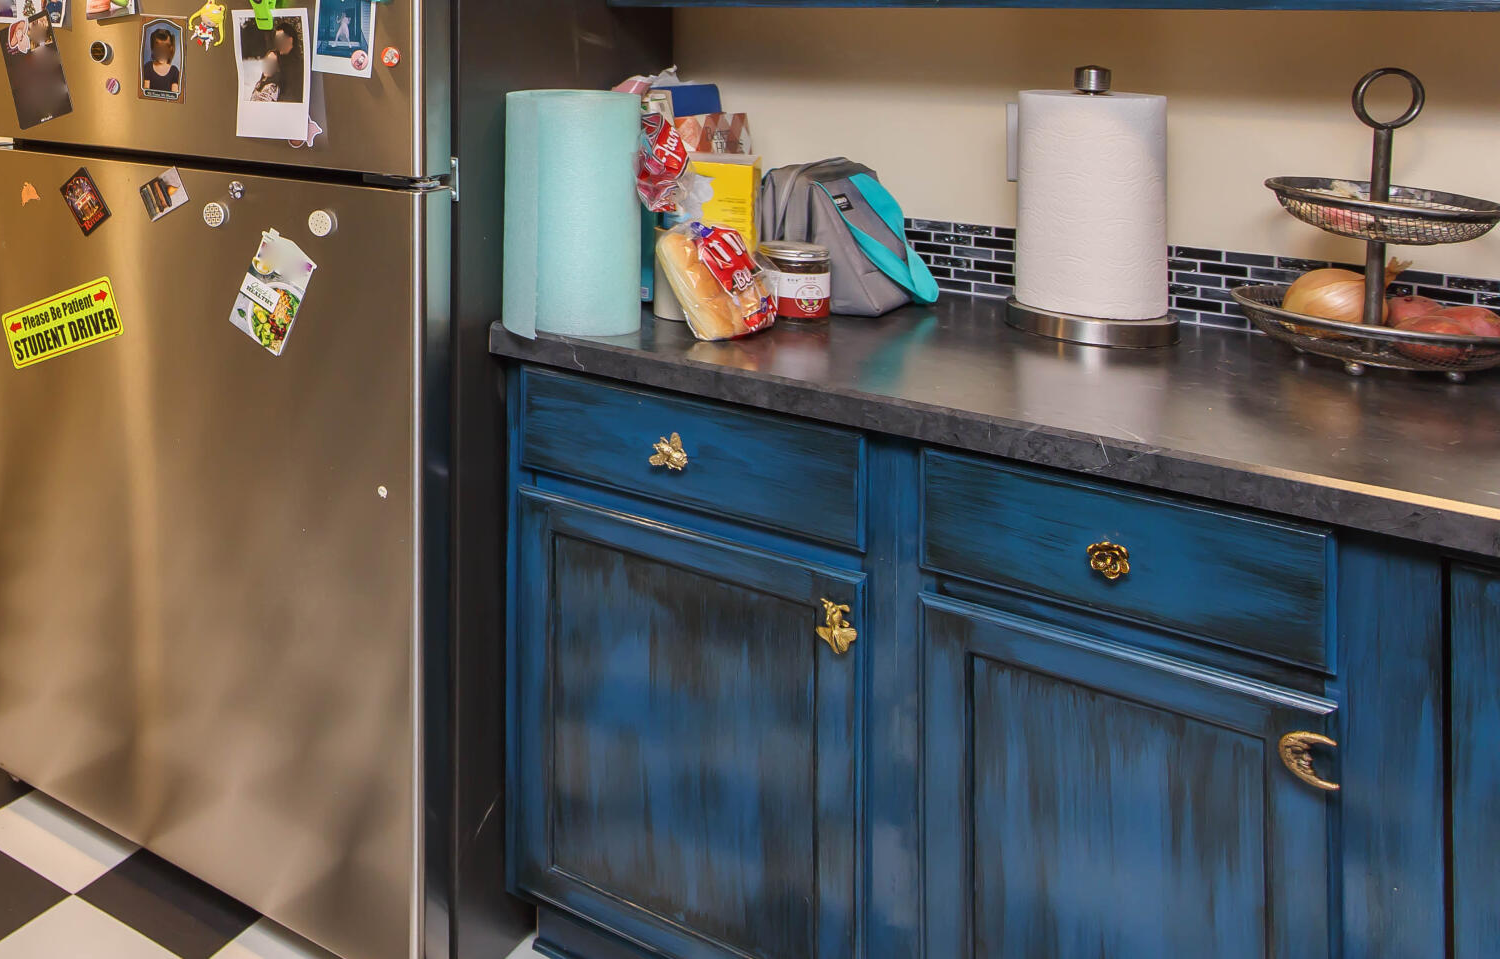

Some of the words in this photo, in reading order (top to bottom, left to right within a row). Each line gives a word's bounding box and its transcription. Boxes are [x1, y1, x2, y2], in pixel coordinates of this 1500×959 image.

[653, 125, 683, 163] Fran
[22, 311, 50, 331] Please
[49, 306, 62, 321] Be
[61, 294, 94, 316] Patient
[13, 324, 68, 361] STUDENT
[68, 307, 118, 343] DRIVER
